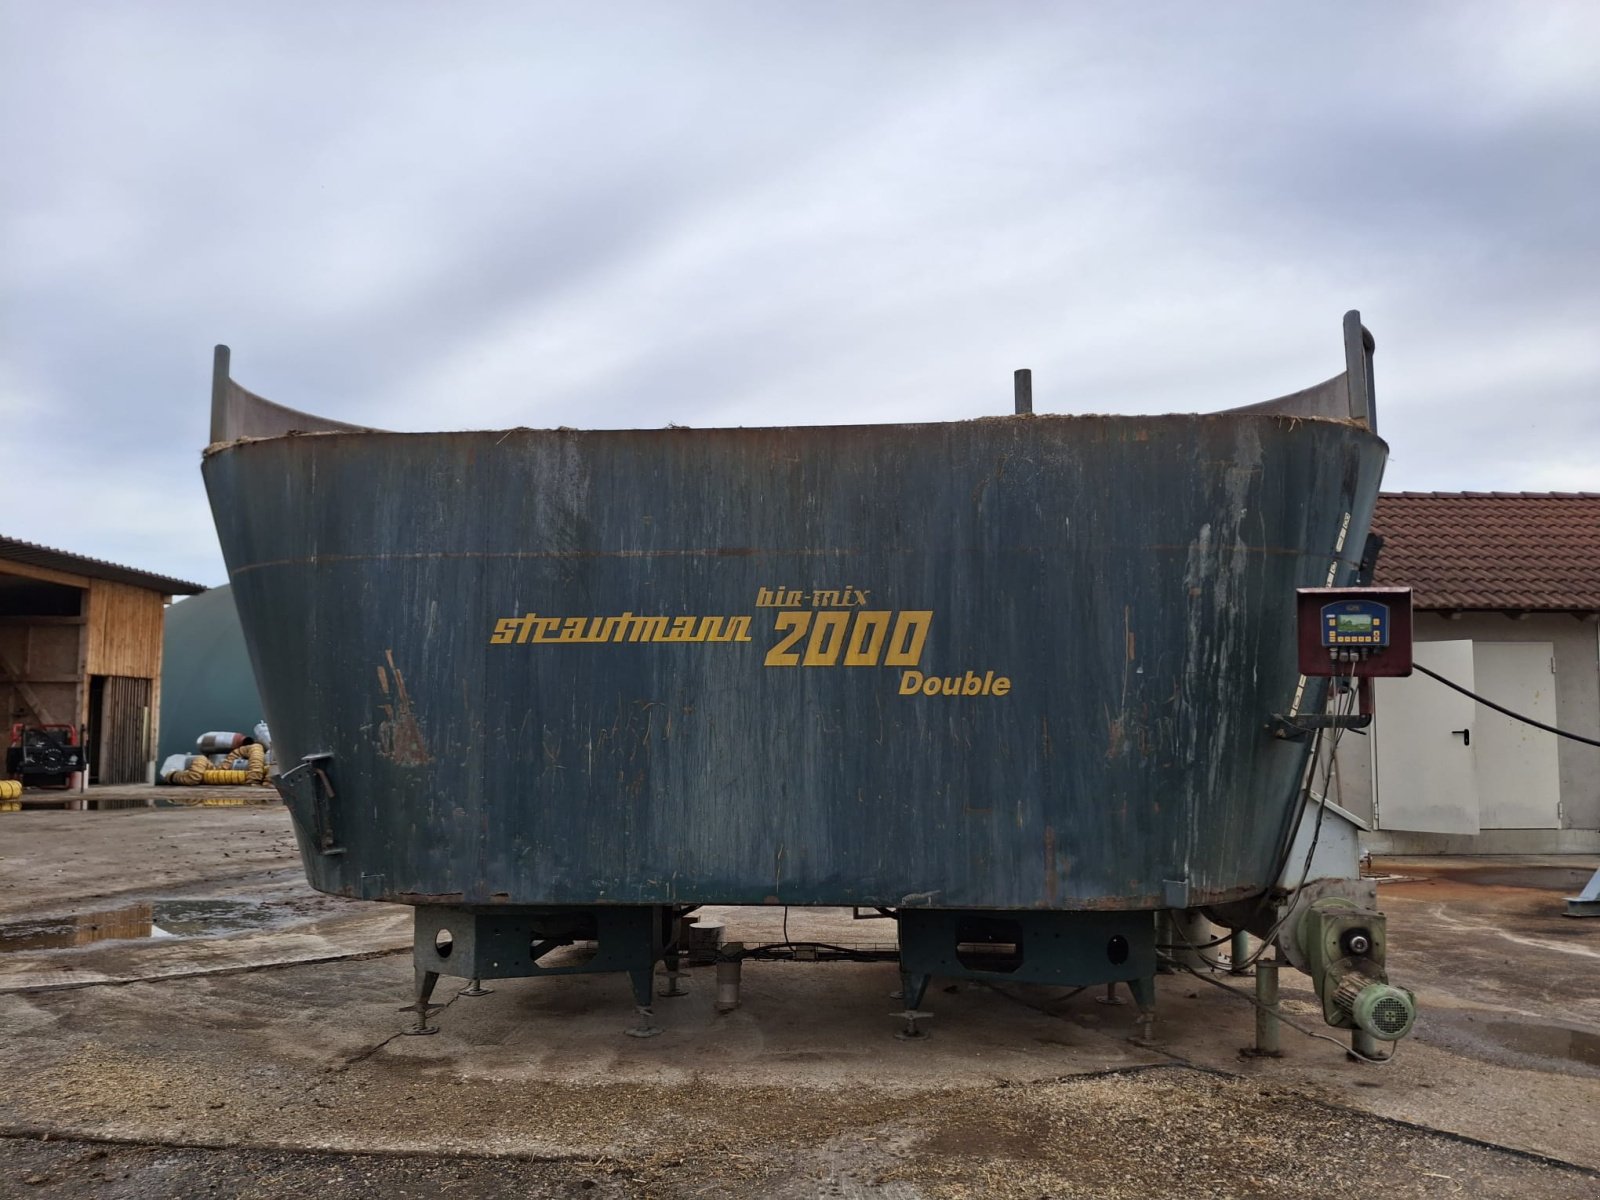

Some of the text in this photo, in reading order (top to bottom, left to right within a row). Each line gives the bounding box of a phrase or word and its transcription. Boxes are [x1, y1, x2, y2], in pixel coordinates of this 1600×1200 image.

[490, 612, 752, 644] strautmann
[764, 611, 933, 666] 2000
[899, 671, 1011, 696] Double
